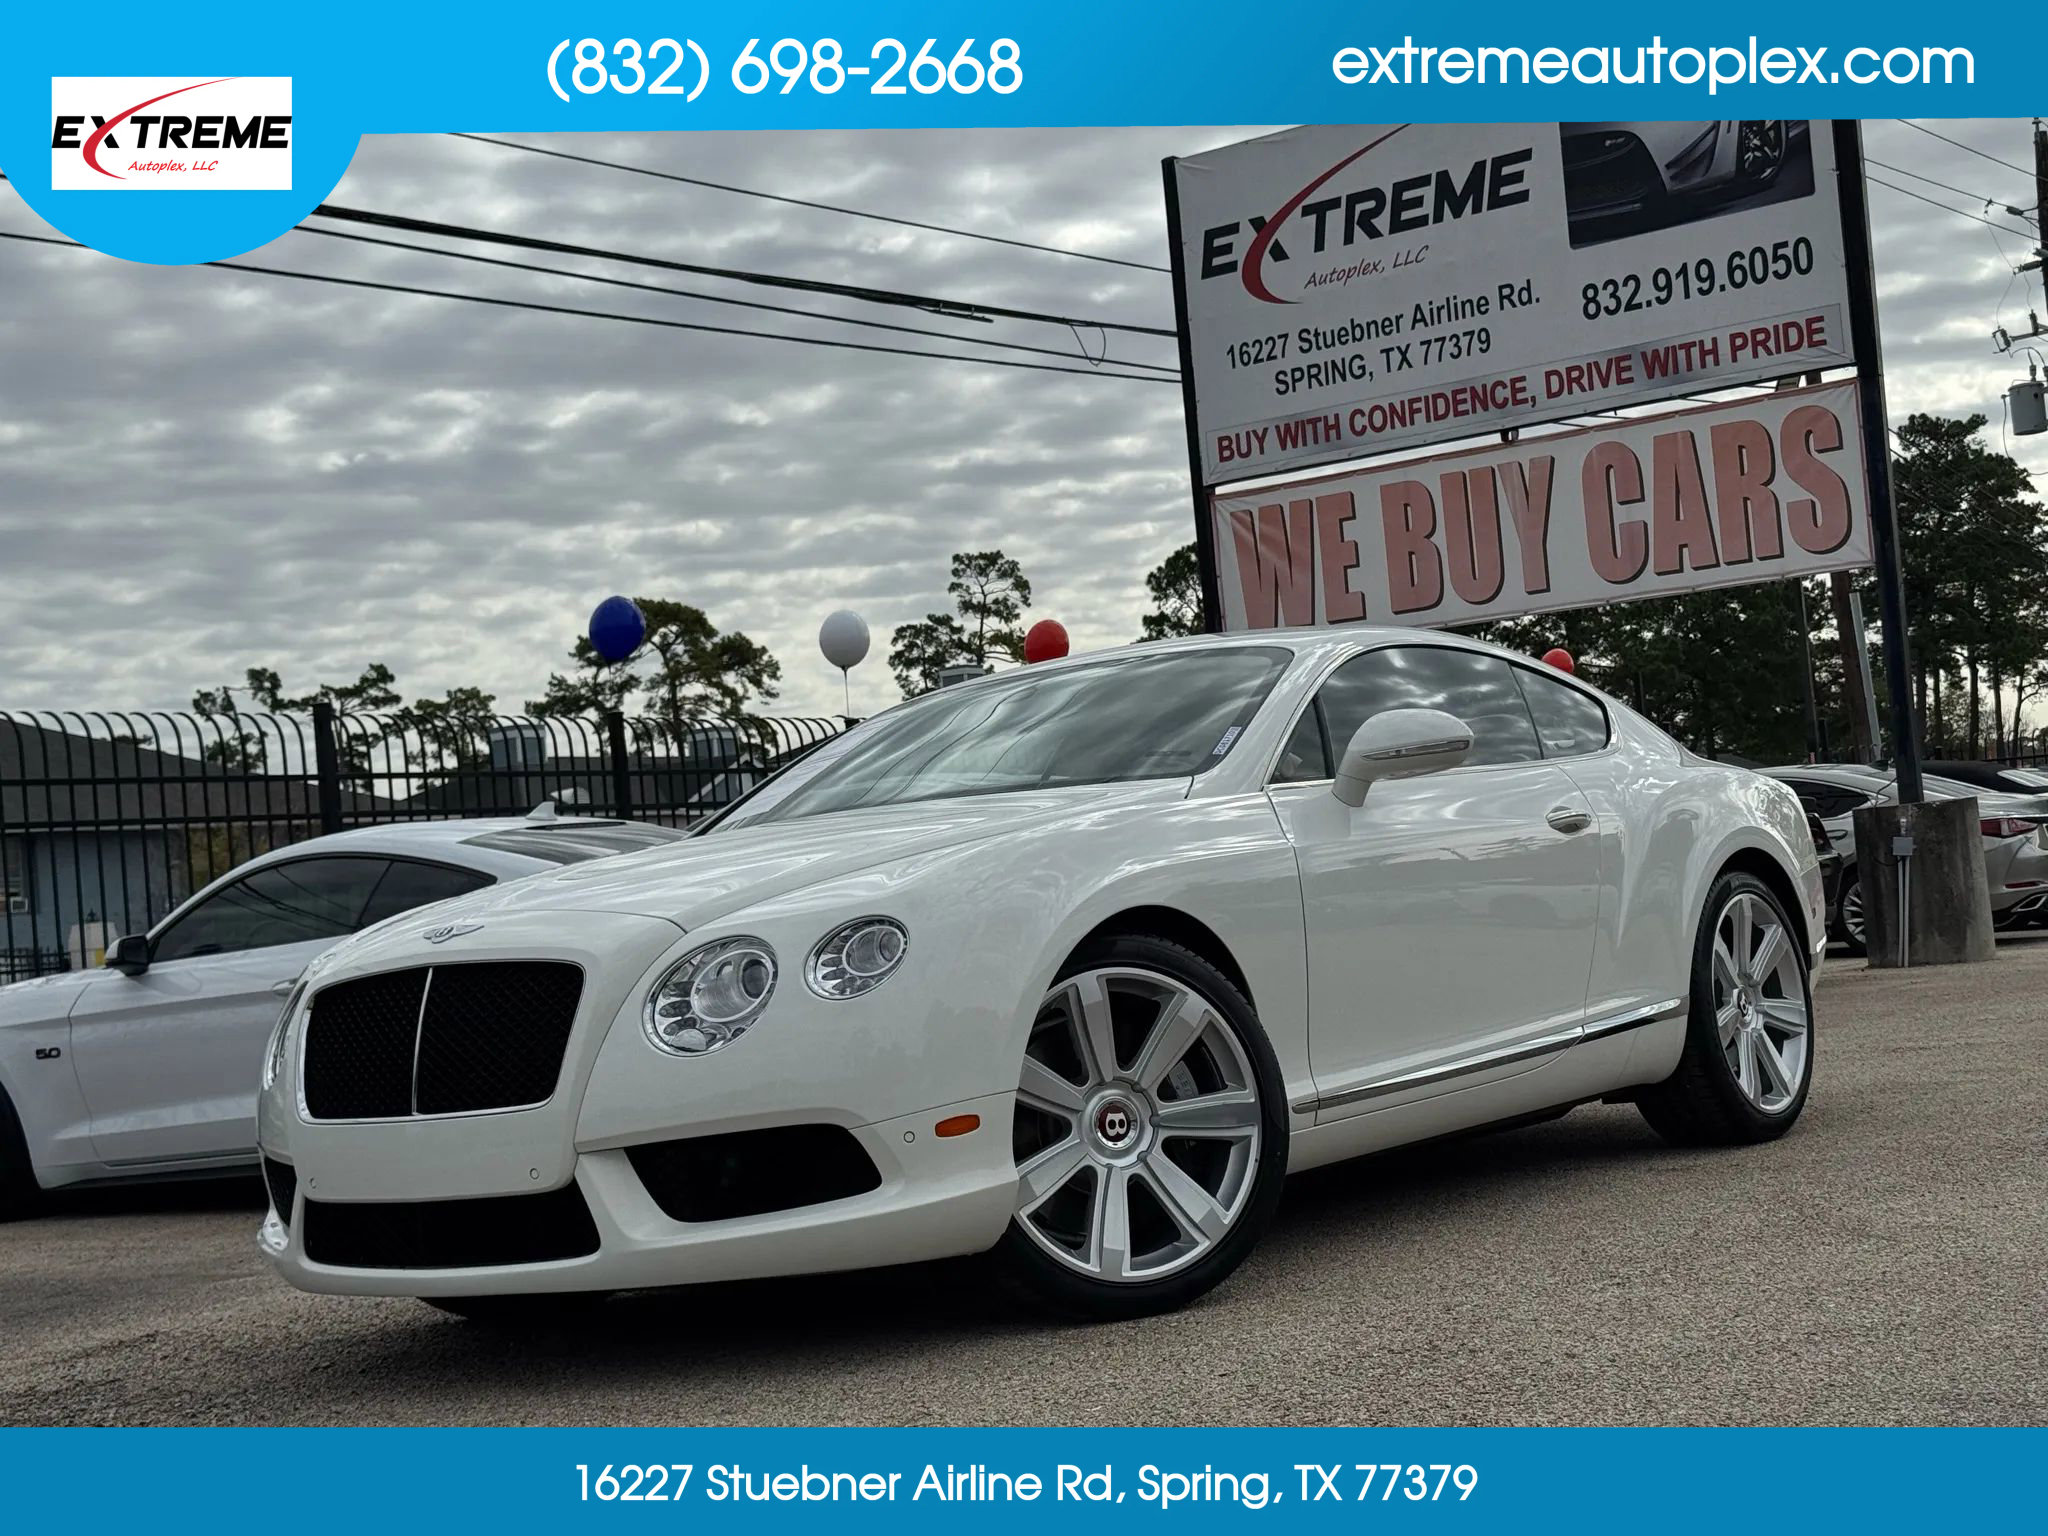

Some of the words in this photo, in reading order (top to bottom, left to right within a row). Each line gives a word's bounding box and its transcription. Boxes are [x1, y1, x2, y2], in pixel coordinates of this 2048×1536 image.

[1201, 148, 1533, 281] EXTREME
[1304, 255, 1385, 289] Autoplex,
[1392, 245, 1429, 270] LLC
[1581, 236, 1814, 321] 832.919.6050
[1226, 333, 1289, 369] 16227
[1297, 313, 1404, 355] Stuebner
[1410, 294, 1490, 331] Airline
[1498, 278, 1541, 312] Rd.
[1274, 353, 1374, 396] SPRING,
[1380, 345, 1414, 374] TX
[1420, 327, 1491, 367] 77379
[1217, 427, 1269, 463] BUY
[1275, 413, 1341, 451] WITH
[1349, 376, 1537, 437] CONFIDENCE,
[1545, 353, 1635, 400] DRIVE
[1640, 337, 1720, 380] WITH
[1729, 315, 1828, 364] PRIDE
[1230, 490, 1367, 631] WE
[1379, 454, 1555, 616] BUY
[1581, 404, 1852, 586] CARS
